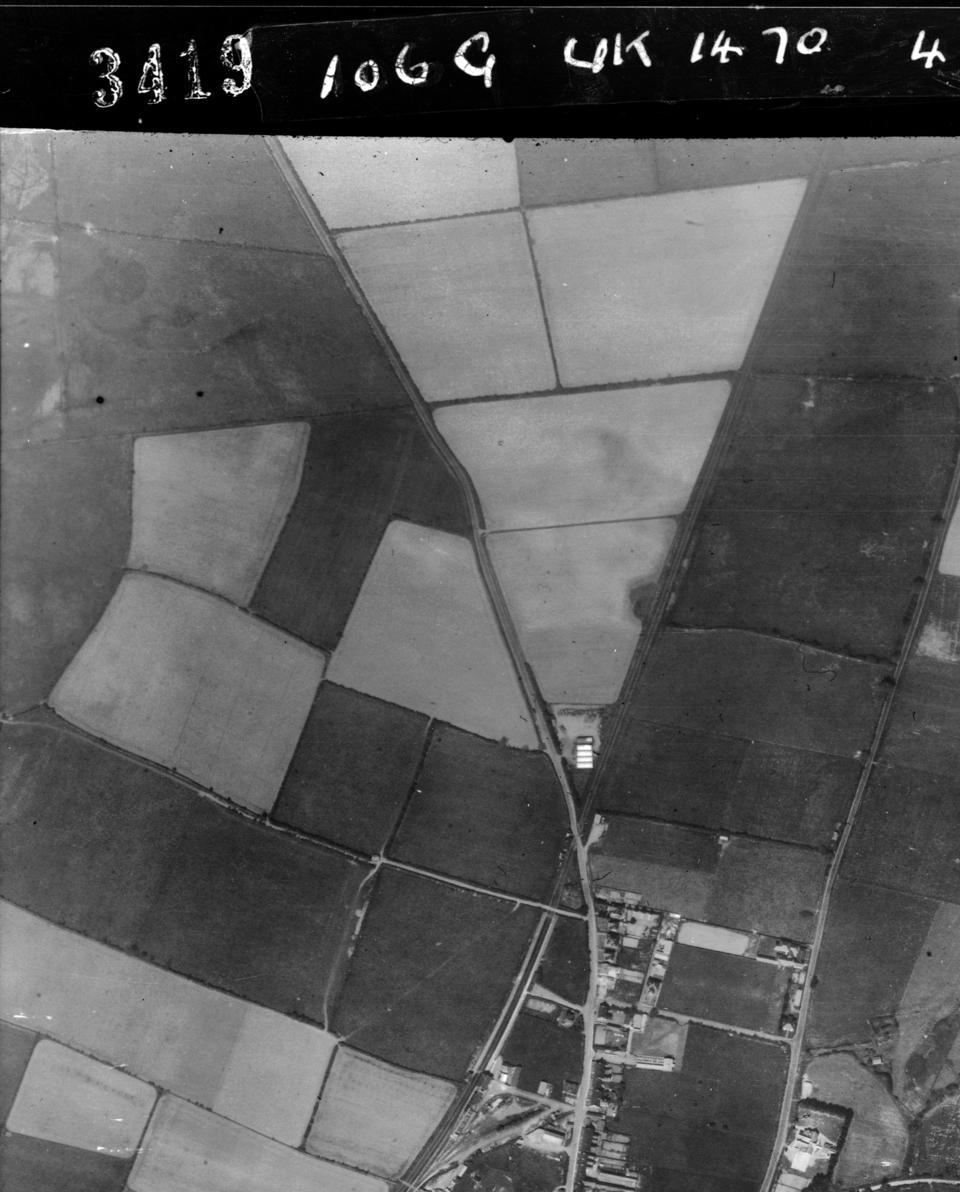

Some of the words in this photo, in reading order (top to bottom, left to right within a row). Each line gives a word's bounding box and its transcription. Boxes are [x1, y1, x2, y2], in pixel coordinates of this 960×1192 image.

[90, 32, 253, 108] 3419
[563, 30, 652, 74] UK
[910, 29, 946, 69] 4
